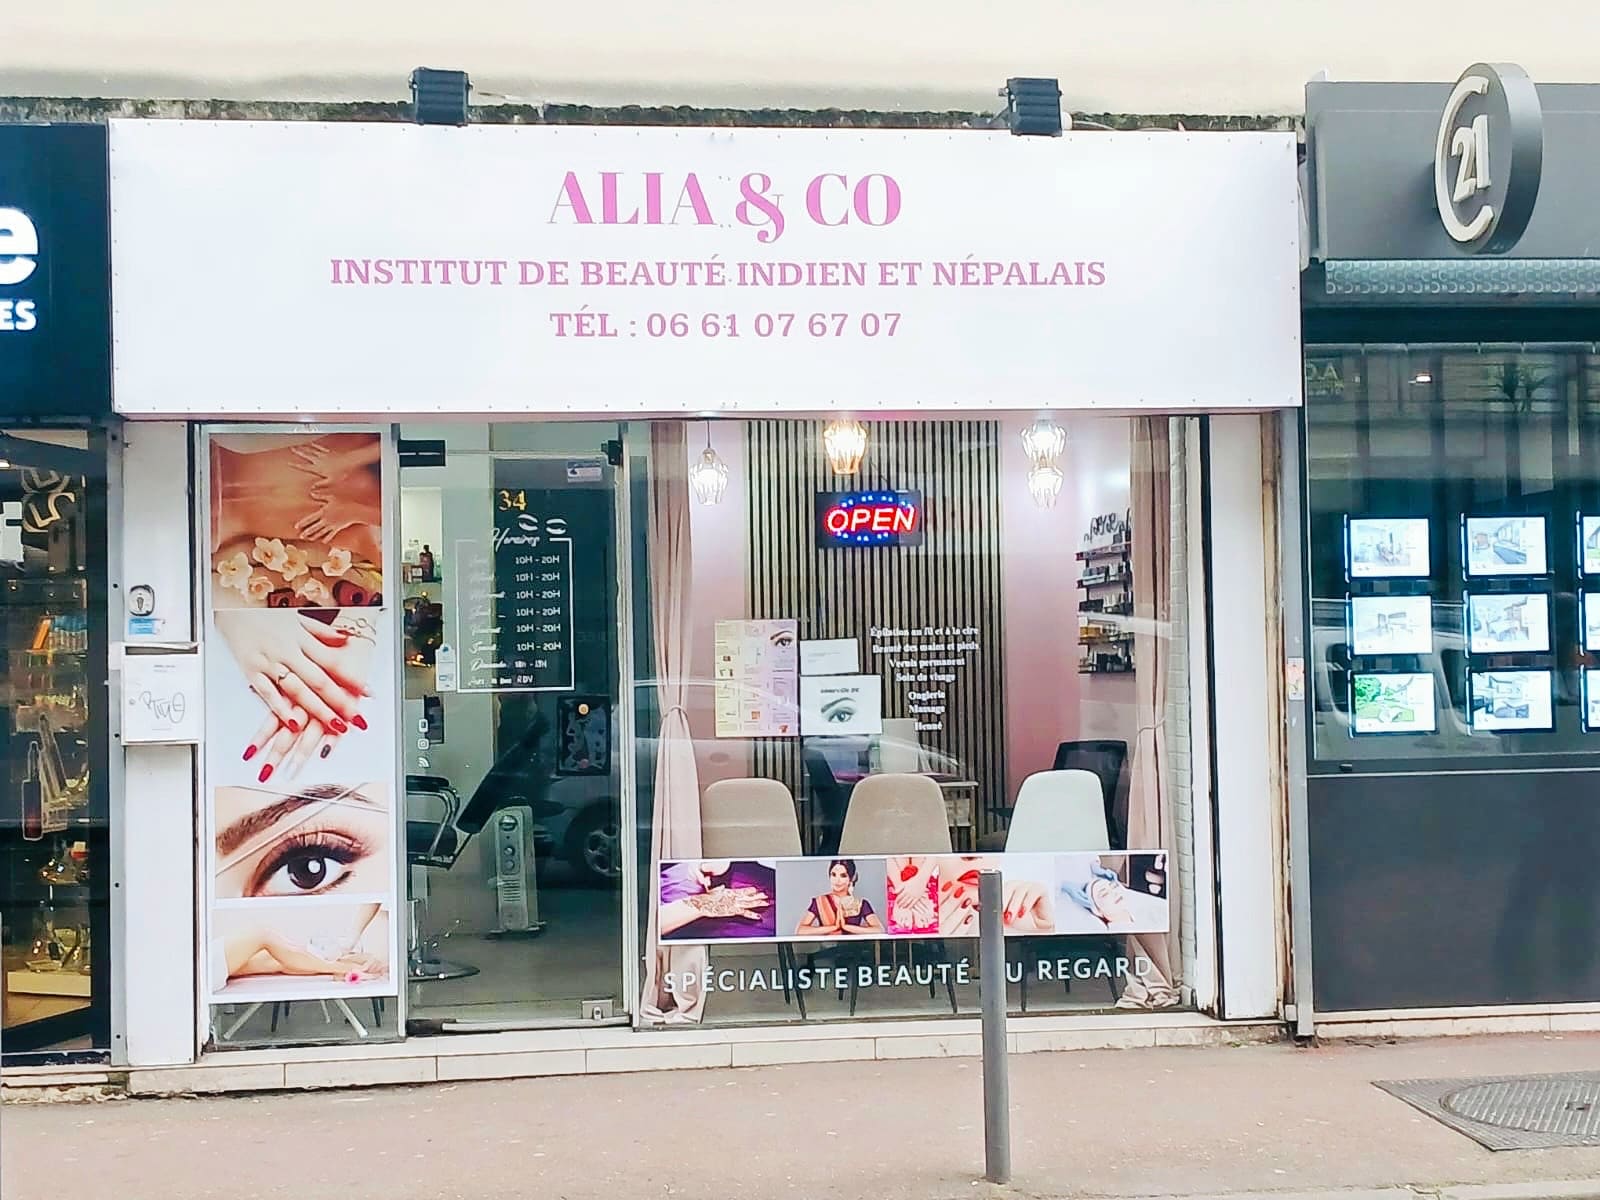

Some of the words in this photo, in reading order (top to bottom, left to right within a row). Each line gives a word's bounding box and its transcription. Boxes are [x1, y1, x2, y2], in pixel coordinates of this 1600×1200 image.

[547, 171, 716, 225] ALIA
[735, 172, 785, 244] &
[806, 173, 902, 226] CO
[331, 259, 507, 285] INSTITUT
[519, 261, 569, 285] DE
[581, 253, 726, 286] BEAUTÉ
[737, 261, 867, 286] INDIEN
[878, 261, 922, 286] ET
[932, 253, 1106, 286] NÉPALAIS
[549, 304, 619, 337] TÉL
[646, 313, 689, 337] 06
[701, 313, 740, 337] 61
[754, 313, 796, 337] 07
[808, 313, 850, 337] 67
[861, 313, 902, 337] 07
[499, 490, 527, 511] 34
[827, 506, 915, 532] OPEN
[664, 964, 849, 993] SPÉCIALISTE
[858, 957, 971, 986] BEAUTÉ
[1038, 956, 1152, 981] REGARD
